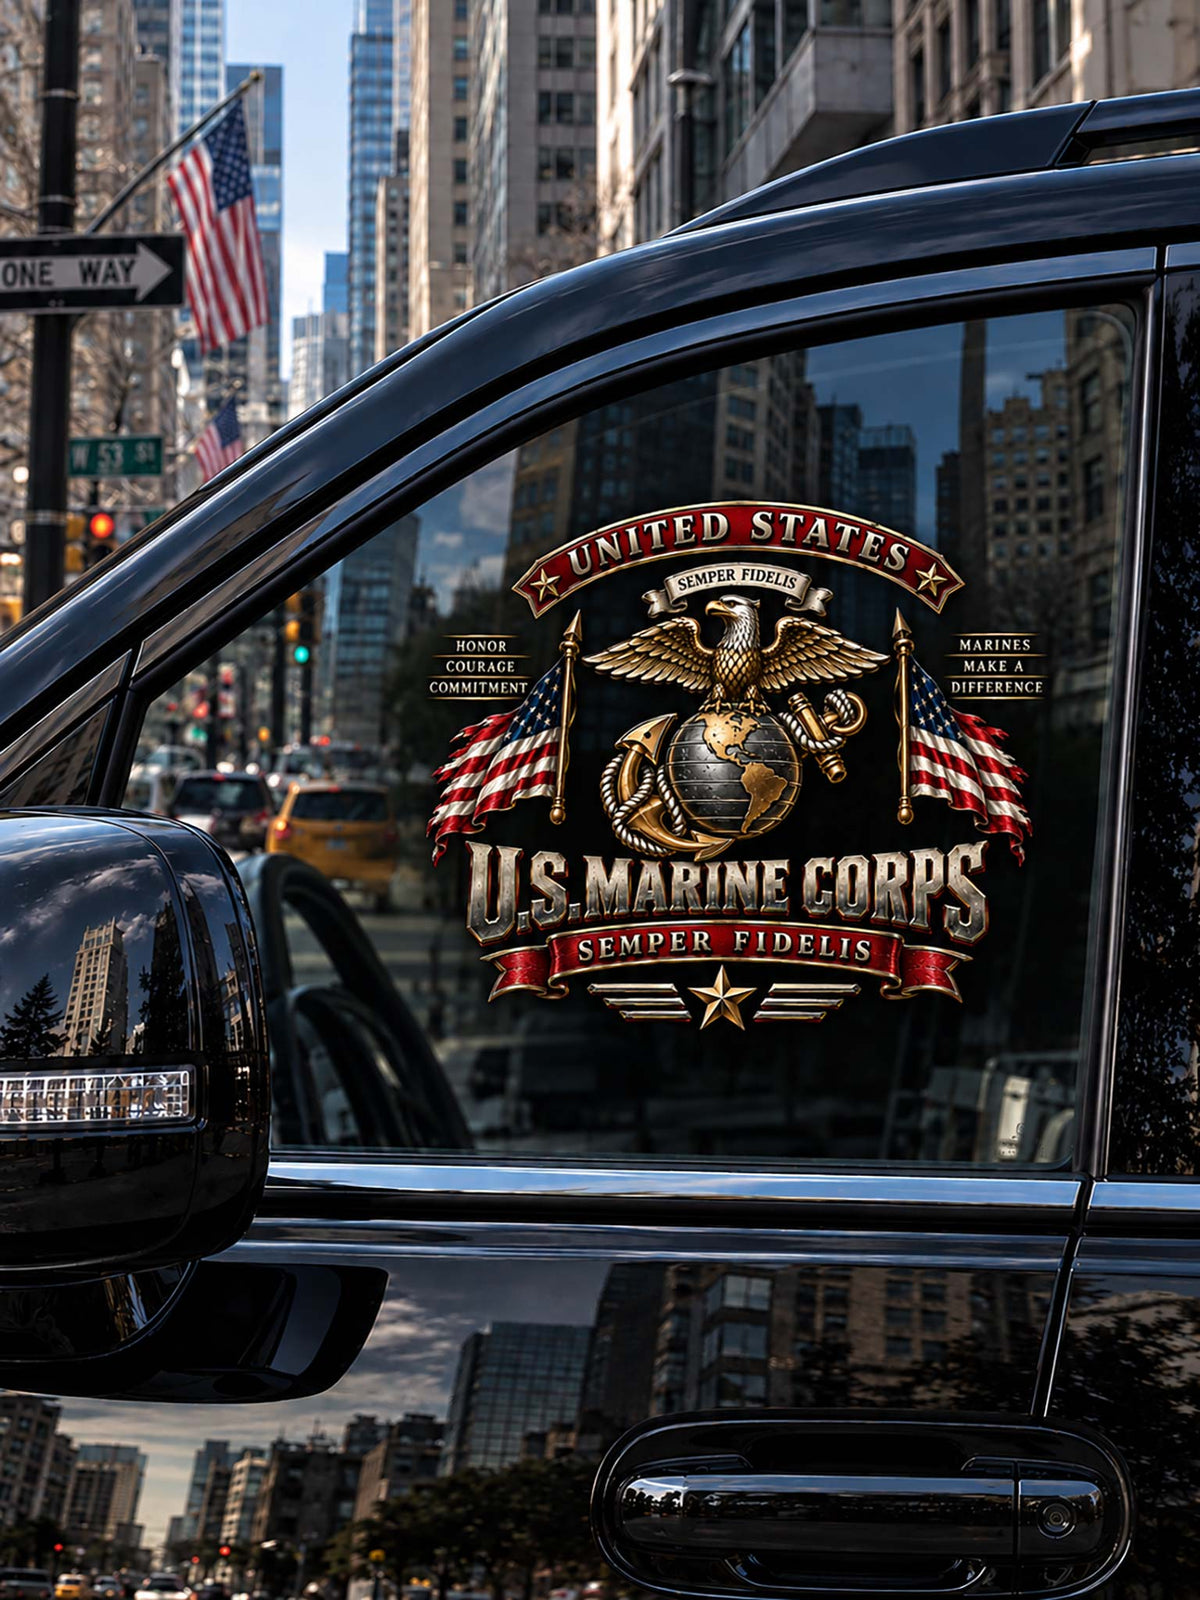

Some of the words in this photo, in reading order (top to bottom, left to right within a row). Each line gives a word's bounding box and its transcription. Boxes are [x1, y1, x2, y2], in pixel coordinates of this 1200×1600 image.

[2, 261, 53, 287] ONE
[79, 259, 135, 284] WAY
[72, 444, 89, 470] W
[567, 512, 728, 577] UNITED
[751, 511, 909, 571] STATES
[678, 568, 736, 591] SEMPER
[741, 568, 797, 590] FIDELIS
[455, 640, 507, 653] HONOR
[960, 639, 1031, 651] MARINES
[445, 660, 515, 673] COURAGE
[963, 660, 1007, 673] MAKE
[1014, 660, 1024, 673] A
[429, 681, 528, 694] COMMITMENT
[951, 681, 1043, 694] DIFFERENCE
[801, 840, 989, 946] CORPS
[578, 933, 712, 963] SEMPER
[733, 933, 871, 963] FIDELIS
